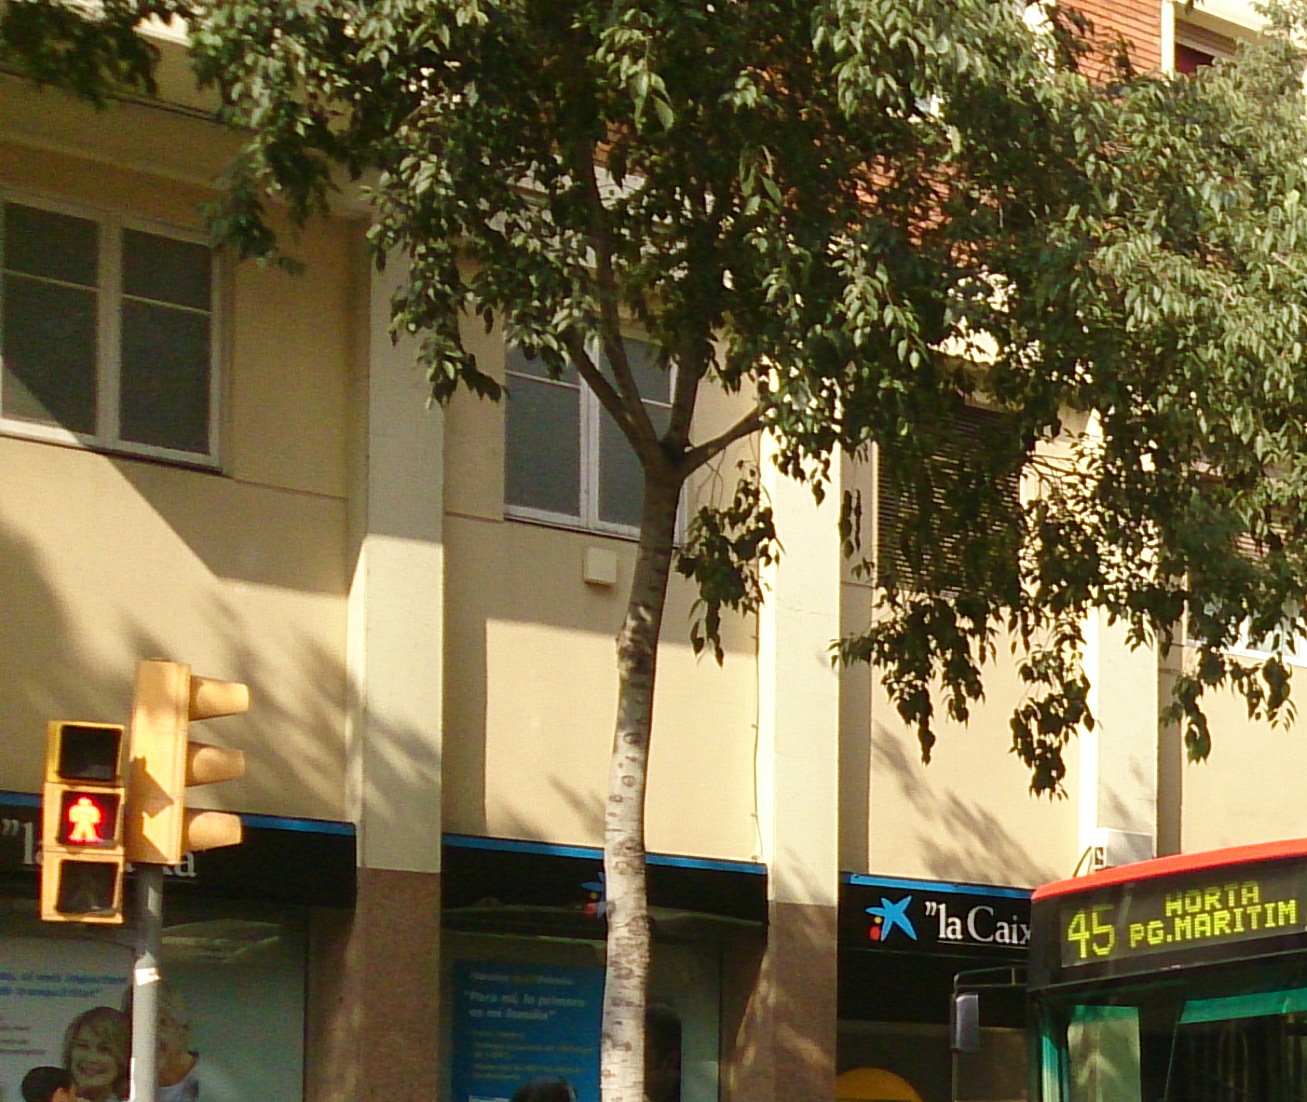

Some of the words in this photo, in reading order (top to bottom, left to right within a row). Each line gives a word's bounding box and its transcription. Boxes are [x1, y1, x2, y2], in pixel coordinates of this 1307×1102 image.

[1165, 881, 1261, 917] HORTA
[1067, 903, 1116, 959] 45
[1130, 899, 1298, 948] PG.MARITIM
